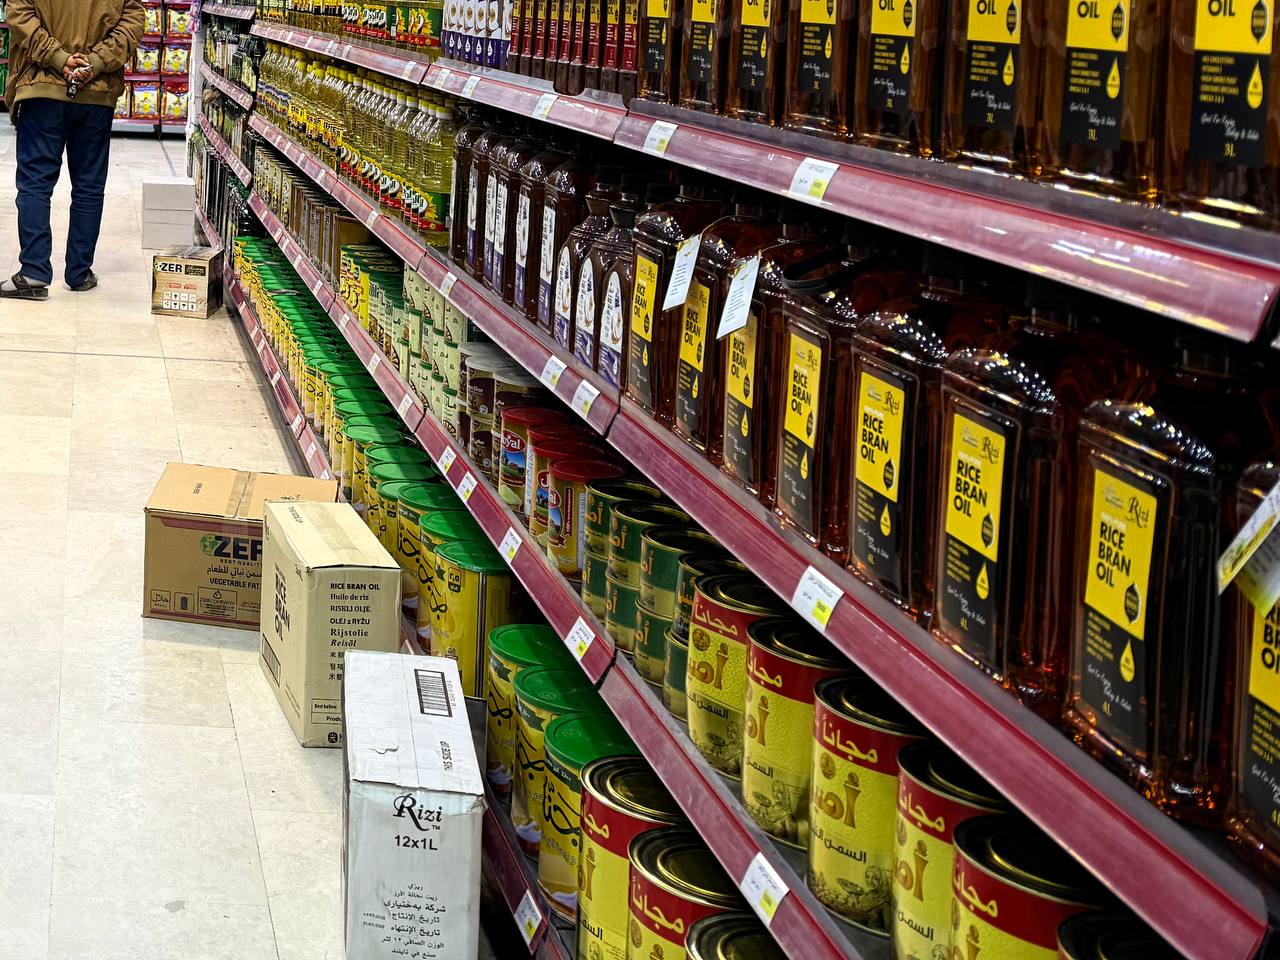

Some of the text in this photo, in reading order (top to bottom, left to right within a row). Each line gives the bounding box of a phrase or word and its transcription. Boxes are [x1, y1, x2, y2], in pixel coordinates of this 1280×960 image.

[976, 0, 997, 16] OIL
[1077, 1, 1100, 19] OIL
[161, 263, 182, 272] ZER
[863, 411, 884, 434] RICE
[861, 429, 889, 454] BRAN
[861, 445, 876, 465] OIL
[957, 459, 981, 485] RICE
[956, 479, 988, 508] BRAN
[954, 494, 972, 517] OIL
[1100, 521, 1125, 550] RICE
[1098, 544, 1132, 577] BRAN
[210, 578, 259, 589] VEGETABLE FAT
[1096, 561, 1115, 588] OIL
[352, 617, 370, 625] RYŻU
[330, 628, 369, 638] Rijstolie
[392, 792, 442, 832] Rizi
[394, 835, 438, 850] 12x1L
[425, 903, 446, 913] شركة
[419, 915, 440, 924] تاريخ
[419, 927, 440, 937] تاريخ
